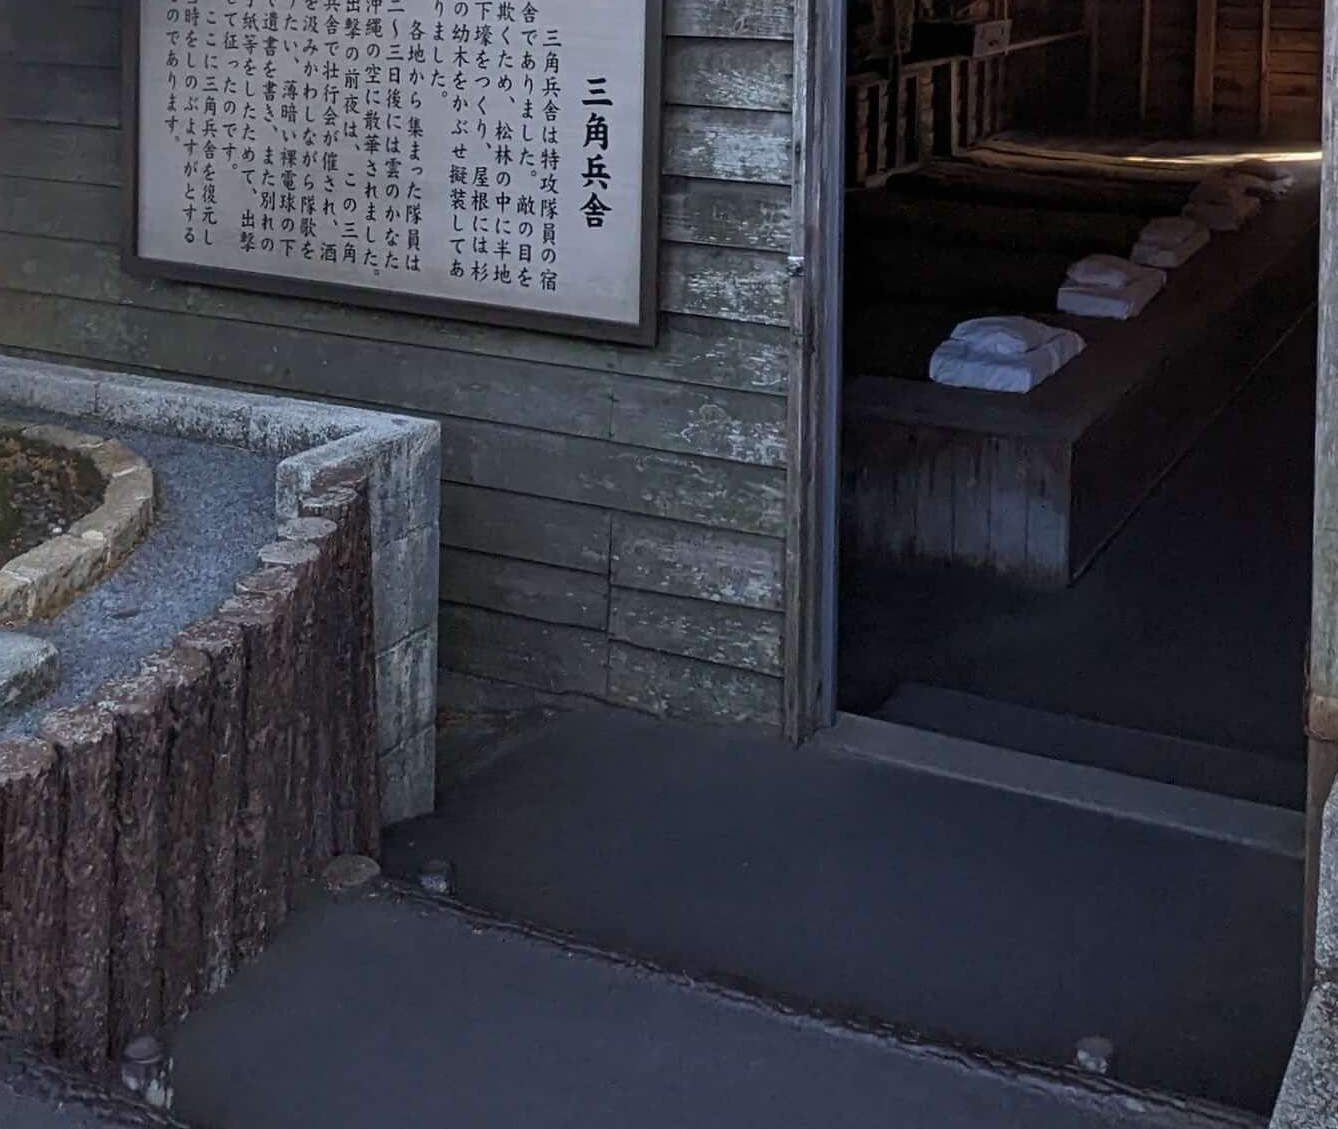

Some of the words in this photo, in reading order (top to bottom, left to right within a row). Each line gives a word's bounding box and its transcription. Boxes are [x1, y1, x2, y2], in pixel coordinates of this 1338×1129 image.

[201, 11, 219, 246] ここに三角兵舎を復元し
[405, 21, 426, 272] 各地から集まった隊員は
[449, 1, 470, 278] の幼木をかぶせ擬装してあ
[470, 1, 493, 282] 下壕をつくり、屋根には杉
[492, 2, 516, 285] 欺くため、松林の中に半地
[517, 1, 539, 288] 舎でありました。敵の目を
[540, 29, 562, 292] 三角兵舎は特攻隊員の宿
[579, 77, 614, 228] 三角兵舎
